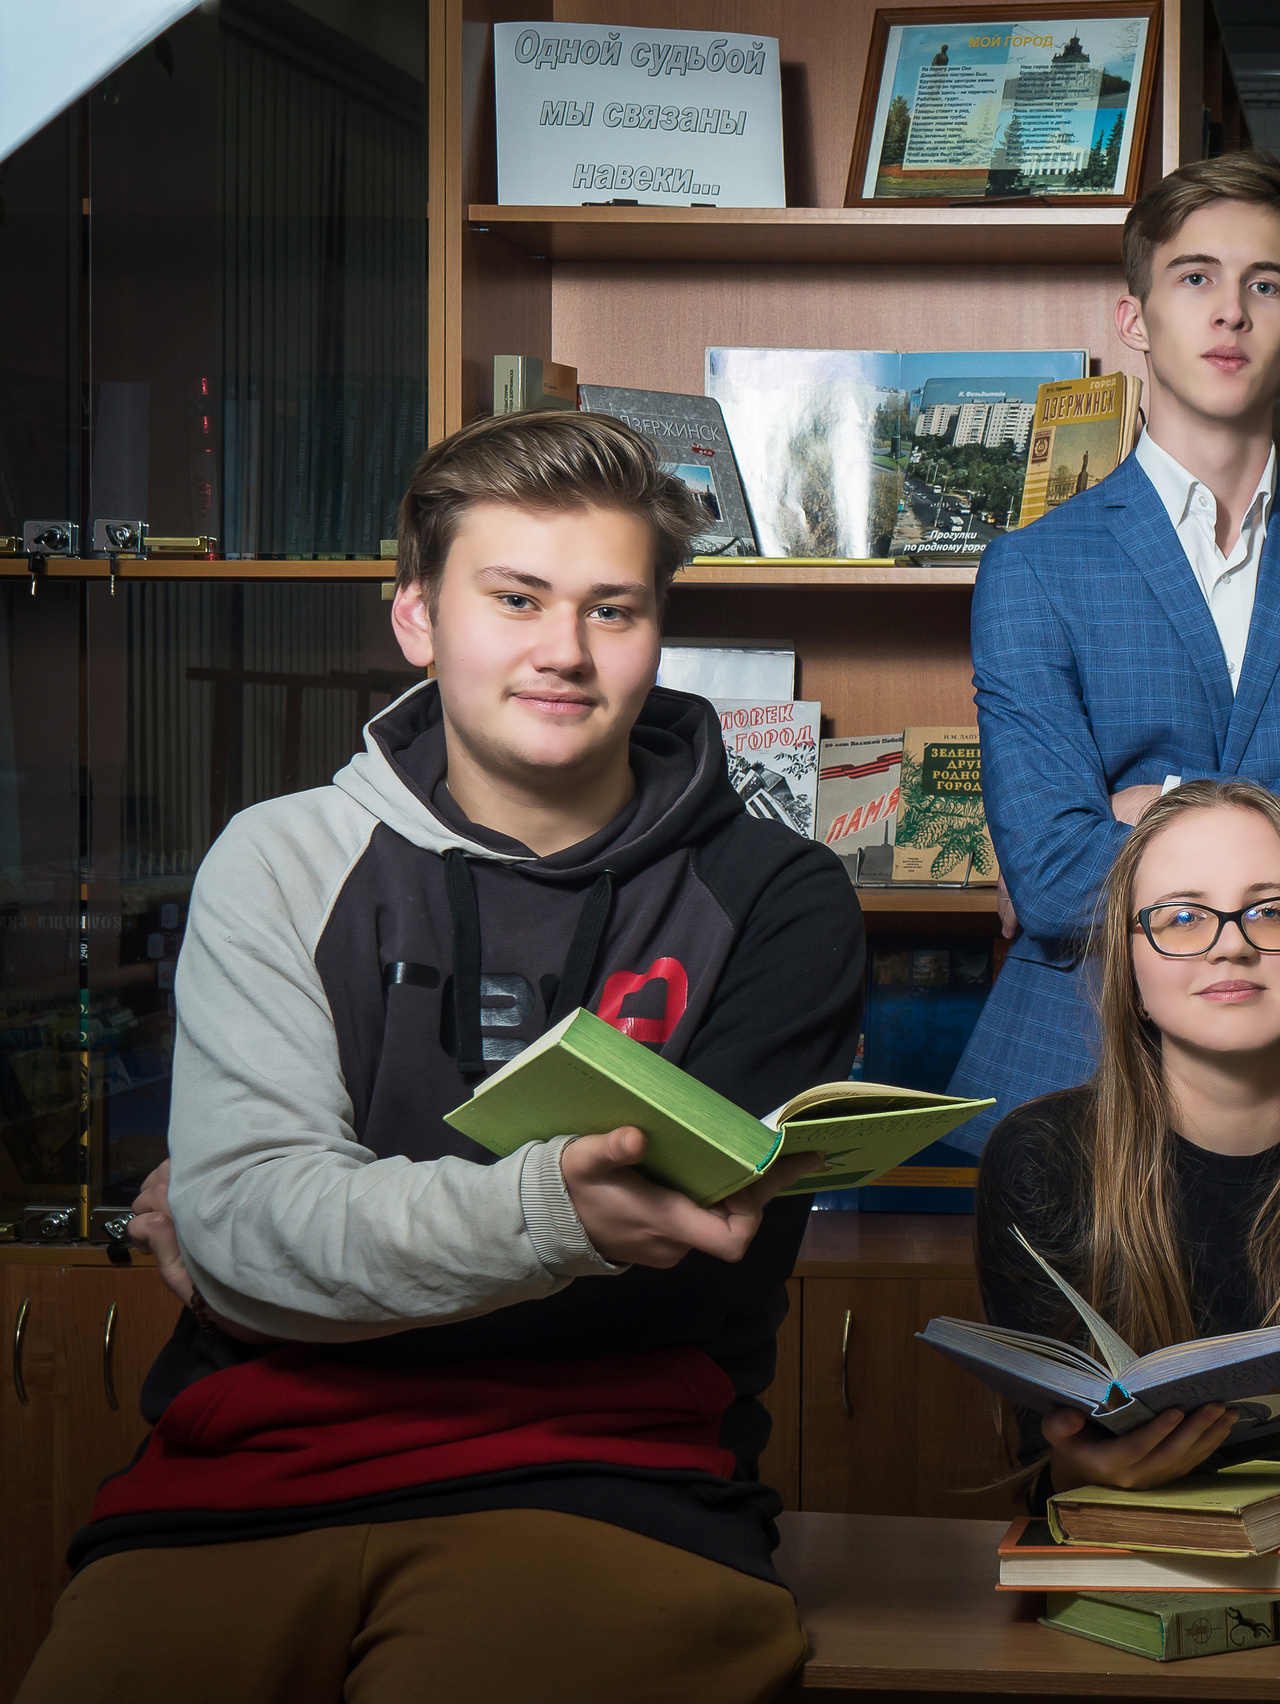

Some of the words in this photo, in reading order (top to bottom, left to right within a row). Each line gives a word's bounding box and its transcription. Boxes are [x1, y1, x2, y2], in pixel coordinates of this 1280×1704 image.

[968, 34, 1001, 48] МОЙ
[1004, 35, 1054, 49] ГОРОД
[514, 29, 623, 70] Одной
[630, 39, 767, 77] судьбой
[539, 100, 595, 127] мы
[602, 102, 748, 136] связаны
[572, 164, 722, 196] навеки...
[1090, 377, 1118, 390] ГОРОД
[1041, 388, 1117, 425] ДЗЕРЖИНСК
[929, 529, 978, 543] Прогулки
[903, 543, 917, 552] по
[916, 542, 963, 554] родному
[735, 725, 814, 752] ГОРОД
[850, 739, 881, 747] Великой
